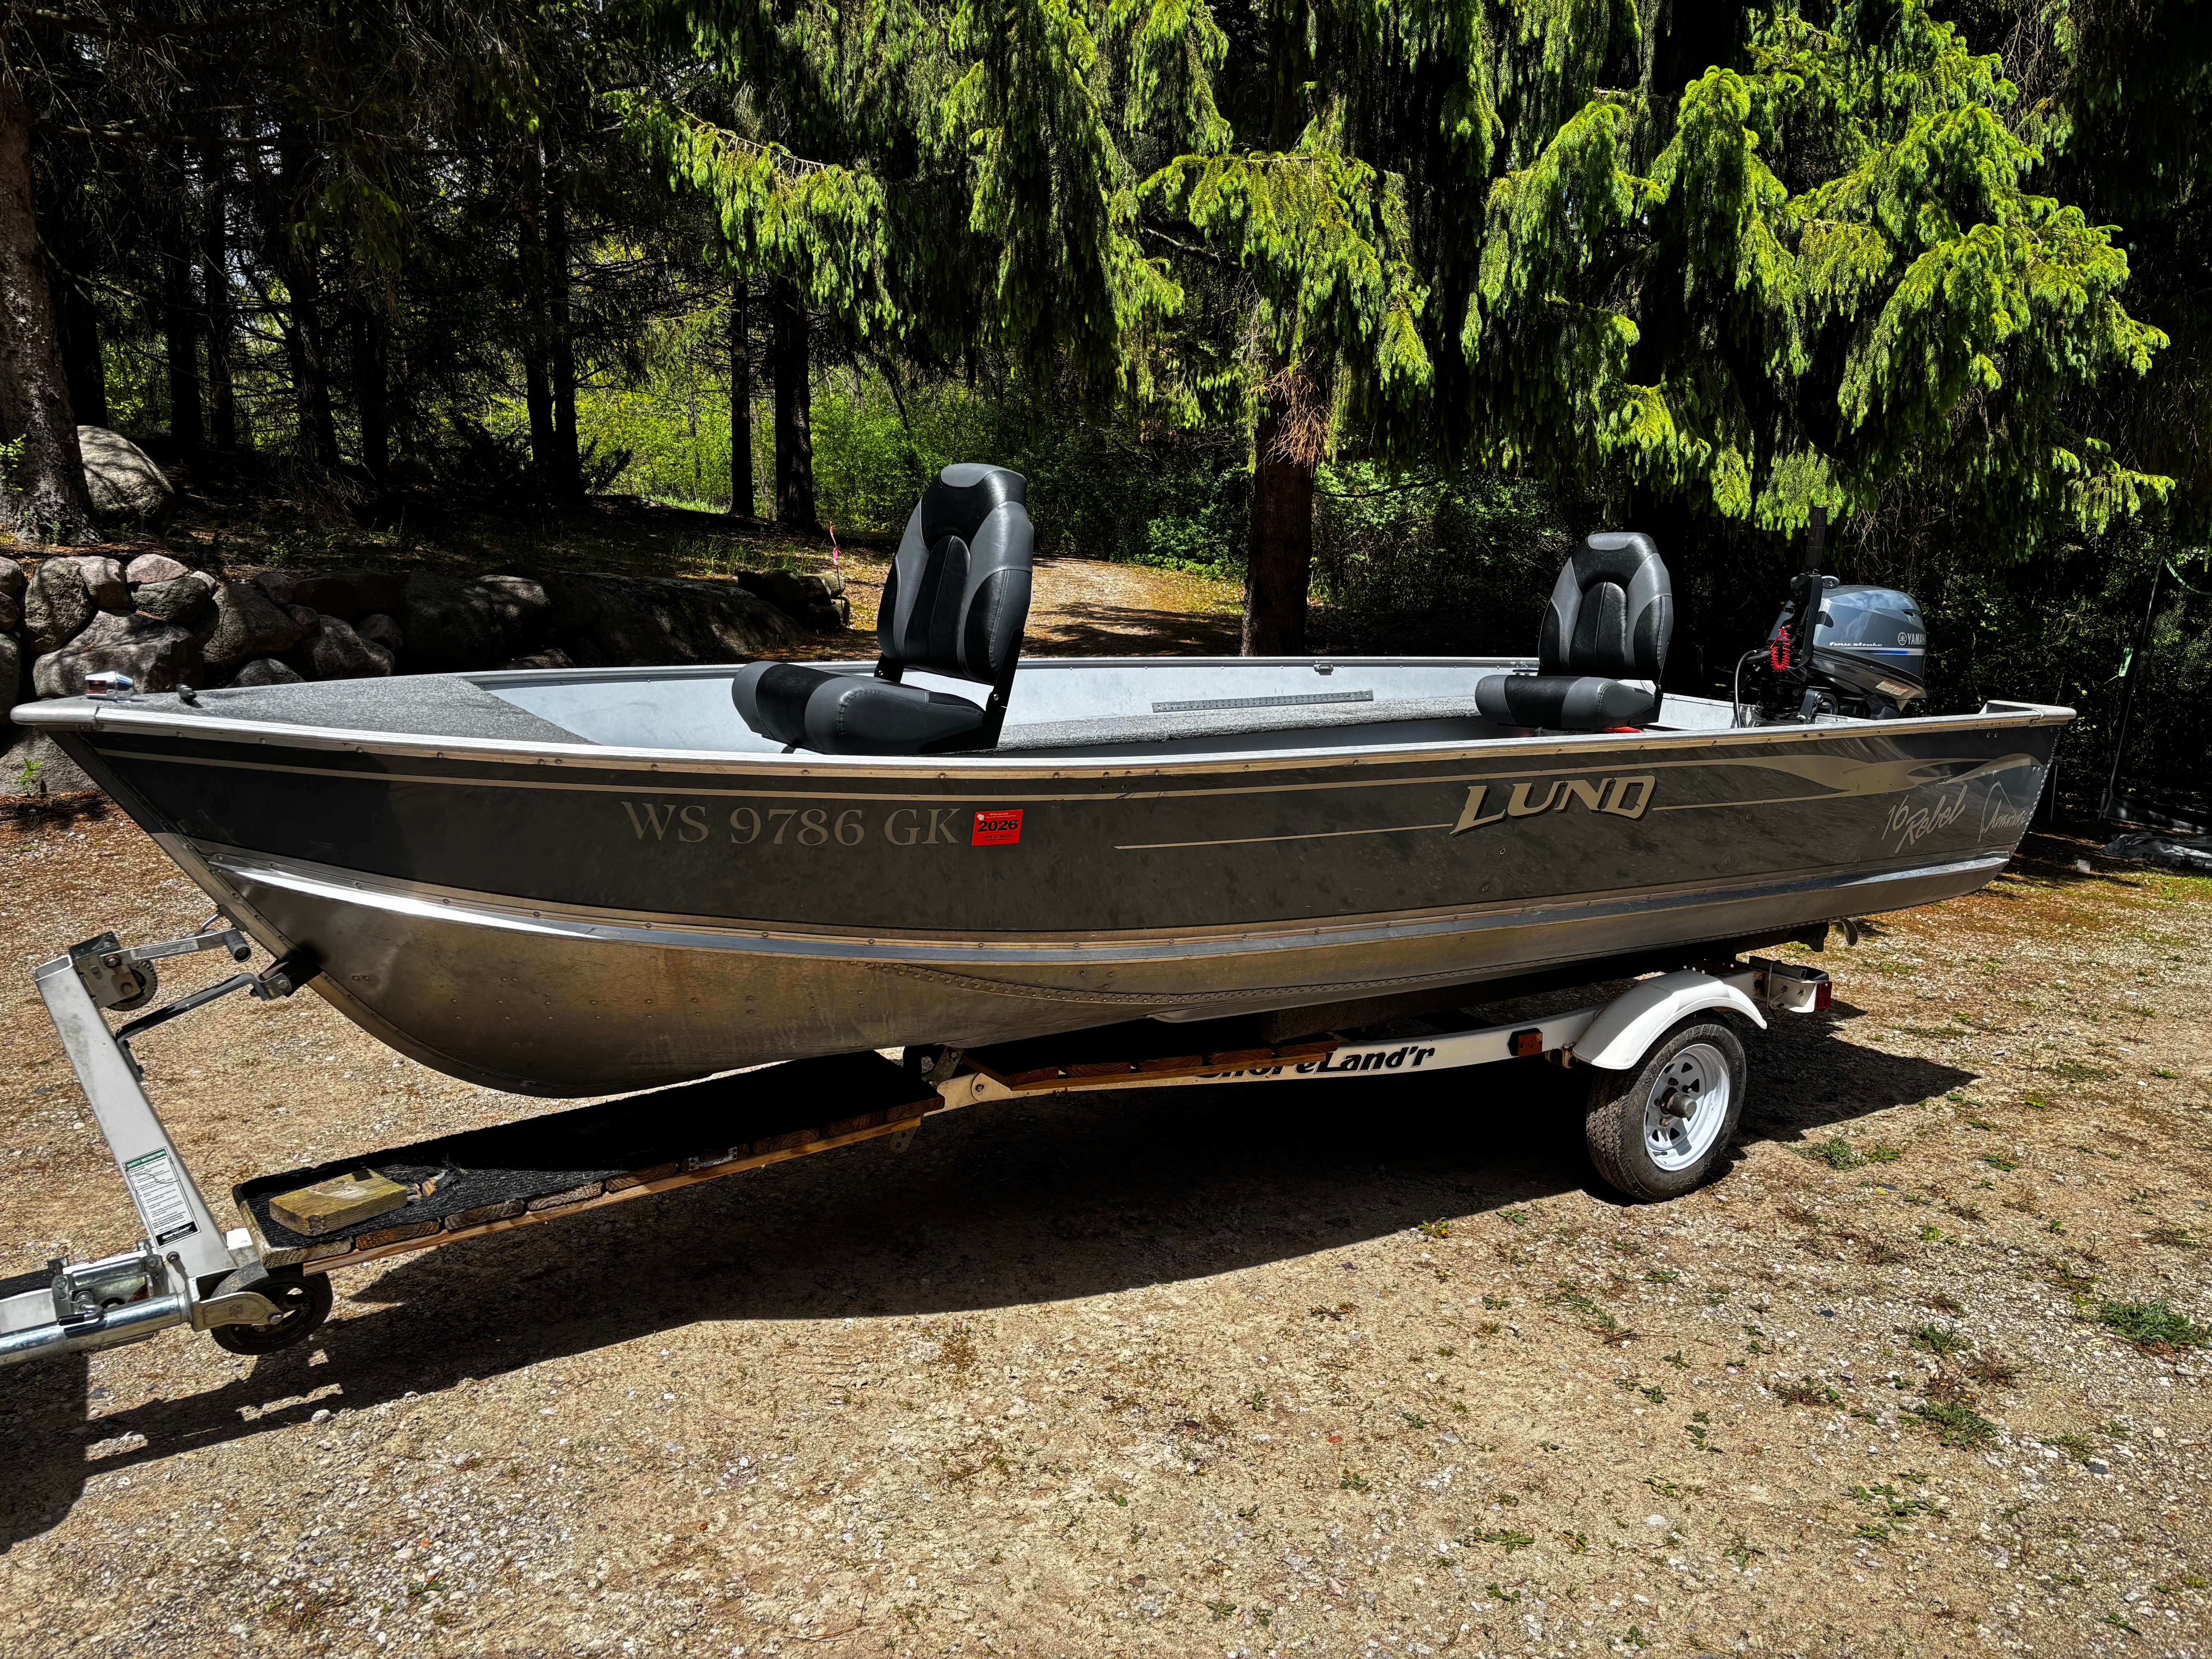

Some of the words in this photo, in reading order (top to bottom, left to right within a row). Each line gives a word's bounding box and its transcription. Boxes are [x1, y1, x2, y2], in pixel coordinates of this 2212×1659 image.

[621, 802, 709, 843] WS
[730, 807, 865, 846] 9786
[884, 808, 960, 845] GK
[977, 819, 1018, 833] 2026
[1449, 775, 1657, 837] LUND
[1881, 794, 1909, 840] 16
[1894, 785, 1967, 853] Rebel
[1644, 1036, 1679, 1087] SPORT
[1685, 1024, 1719, 1042] TRAIL
